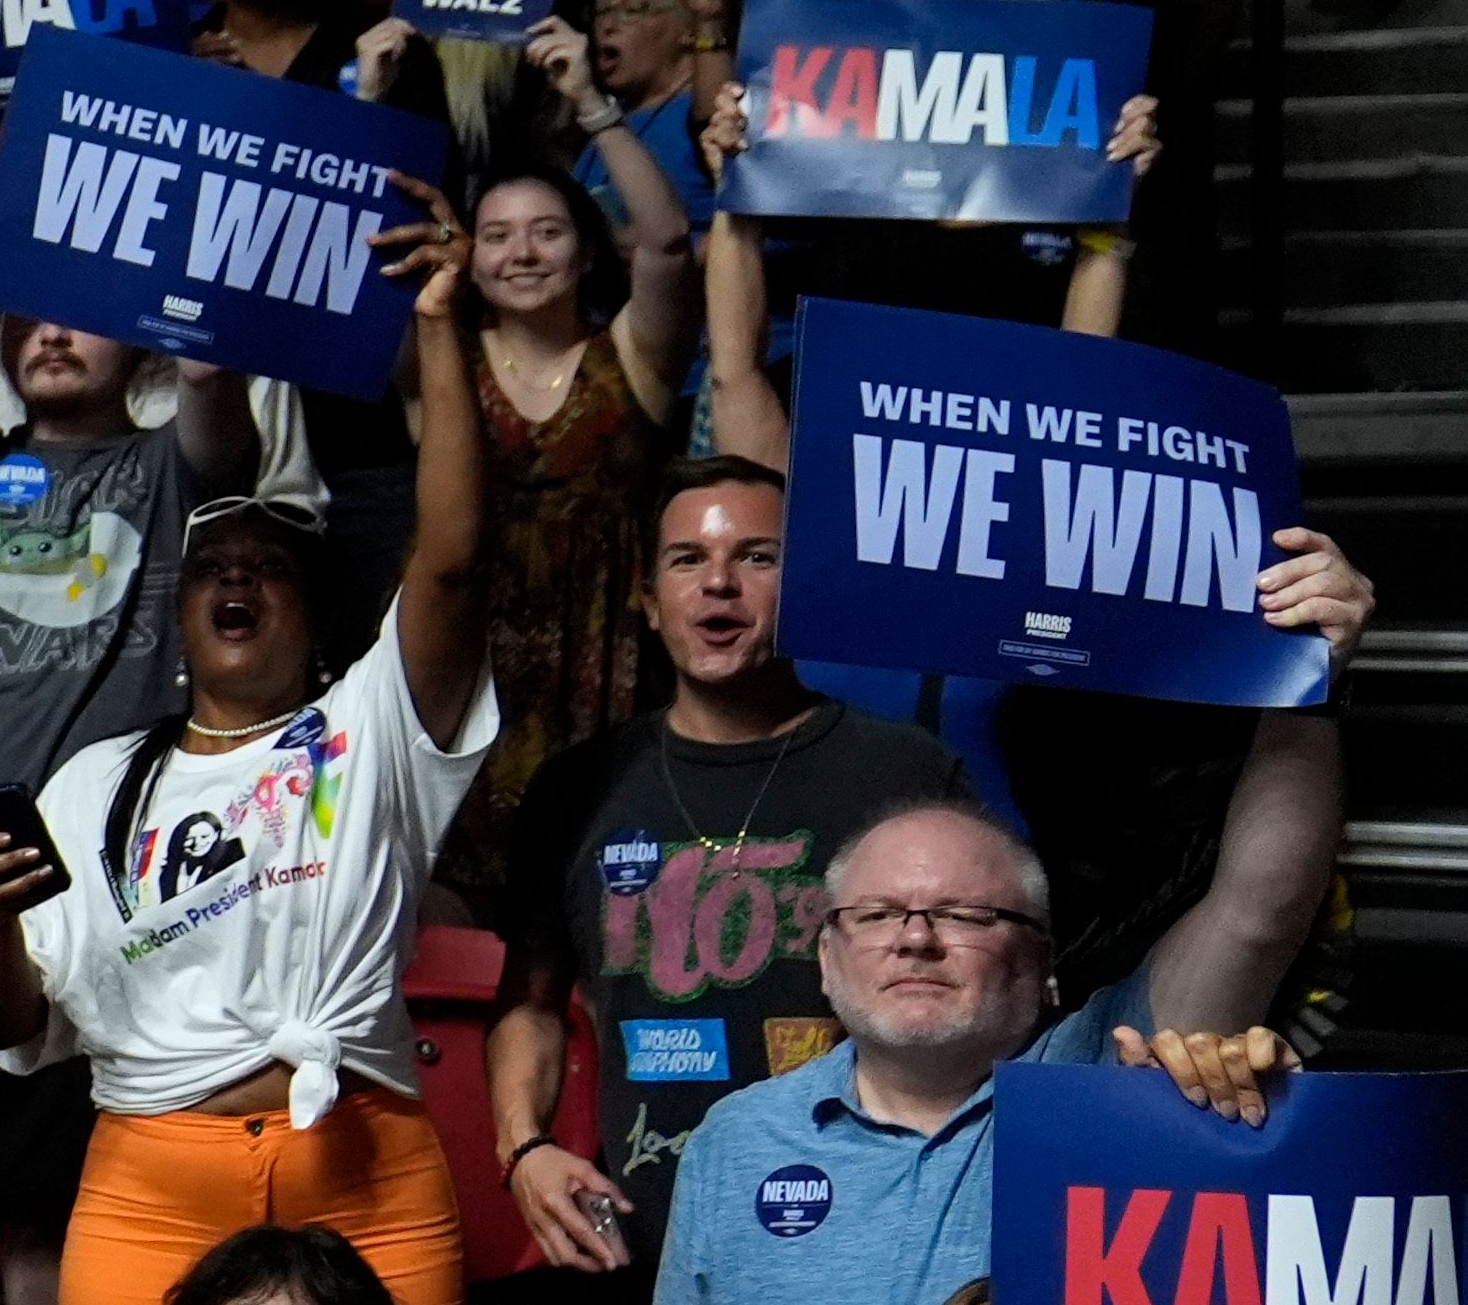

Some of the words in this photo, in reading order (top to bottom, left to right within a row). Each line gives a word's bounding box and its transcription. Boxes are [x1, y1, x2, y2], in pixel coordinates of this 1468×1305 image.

[766, 44, 1101, 149] KAMALA
[60, 91, 186, 149] WHEN
[195, 120, 262, 168] WE
[271, 139, 394, 199] FIGHT
[32, 132, 182, 268] WE
[185, 169, 385, 316] WIN
[859, 380, 1012, 437] WHEN
[1024, 403, 1104, 450] WE
[1116, 417, 1251, 476] FIGHT
[851, 432, 1017, 581] WE
[1040, 459, 1263, 615] WIN
[1024, 611, 1073, 633] HARRIS
[604, 841, 659, 866] NEVADA
[119, 920, 190, 966] Madam
[185, 878, 262, 931] President
[638, 1028, 703, 1051] WORLD
[761, 1179, 831, 1205] NEVADA
